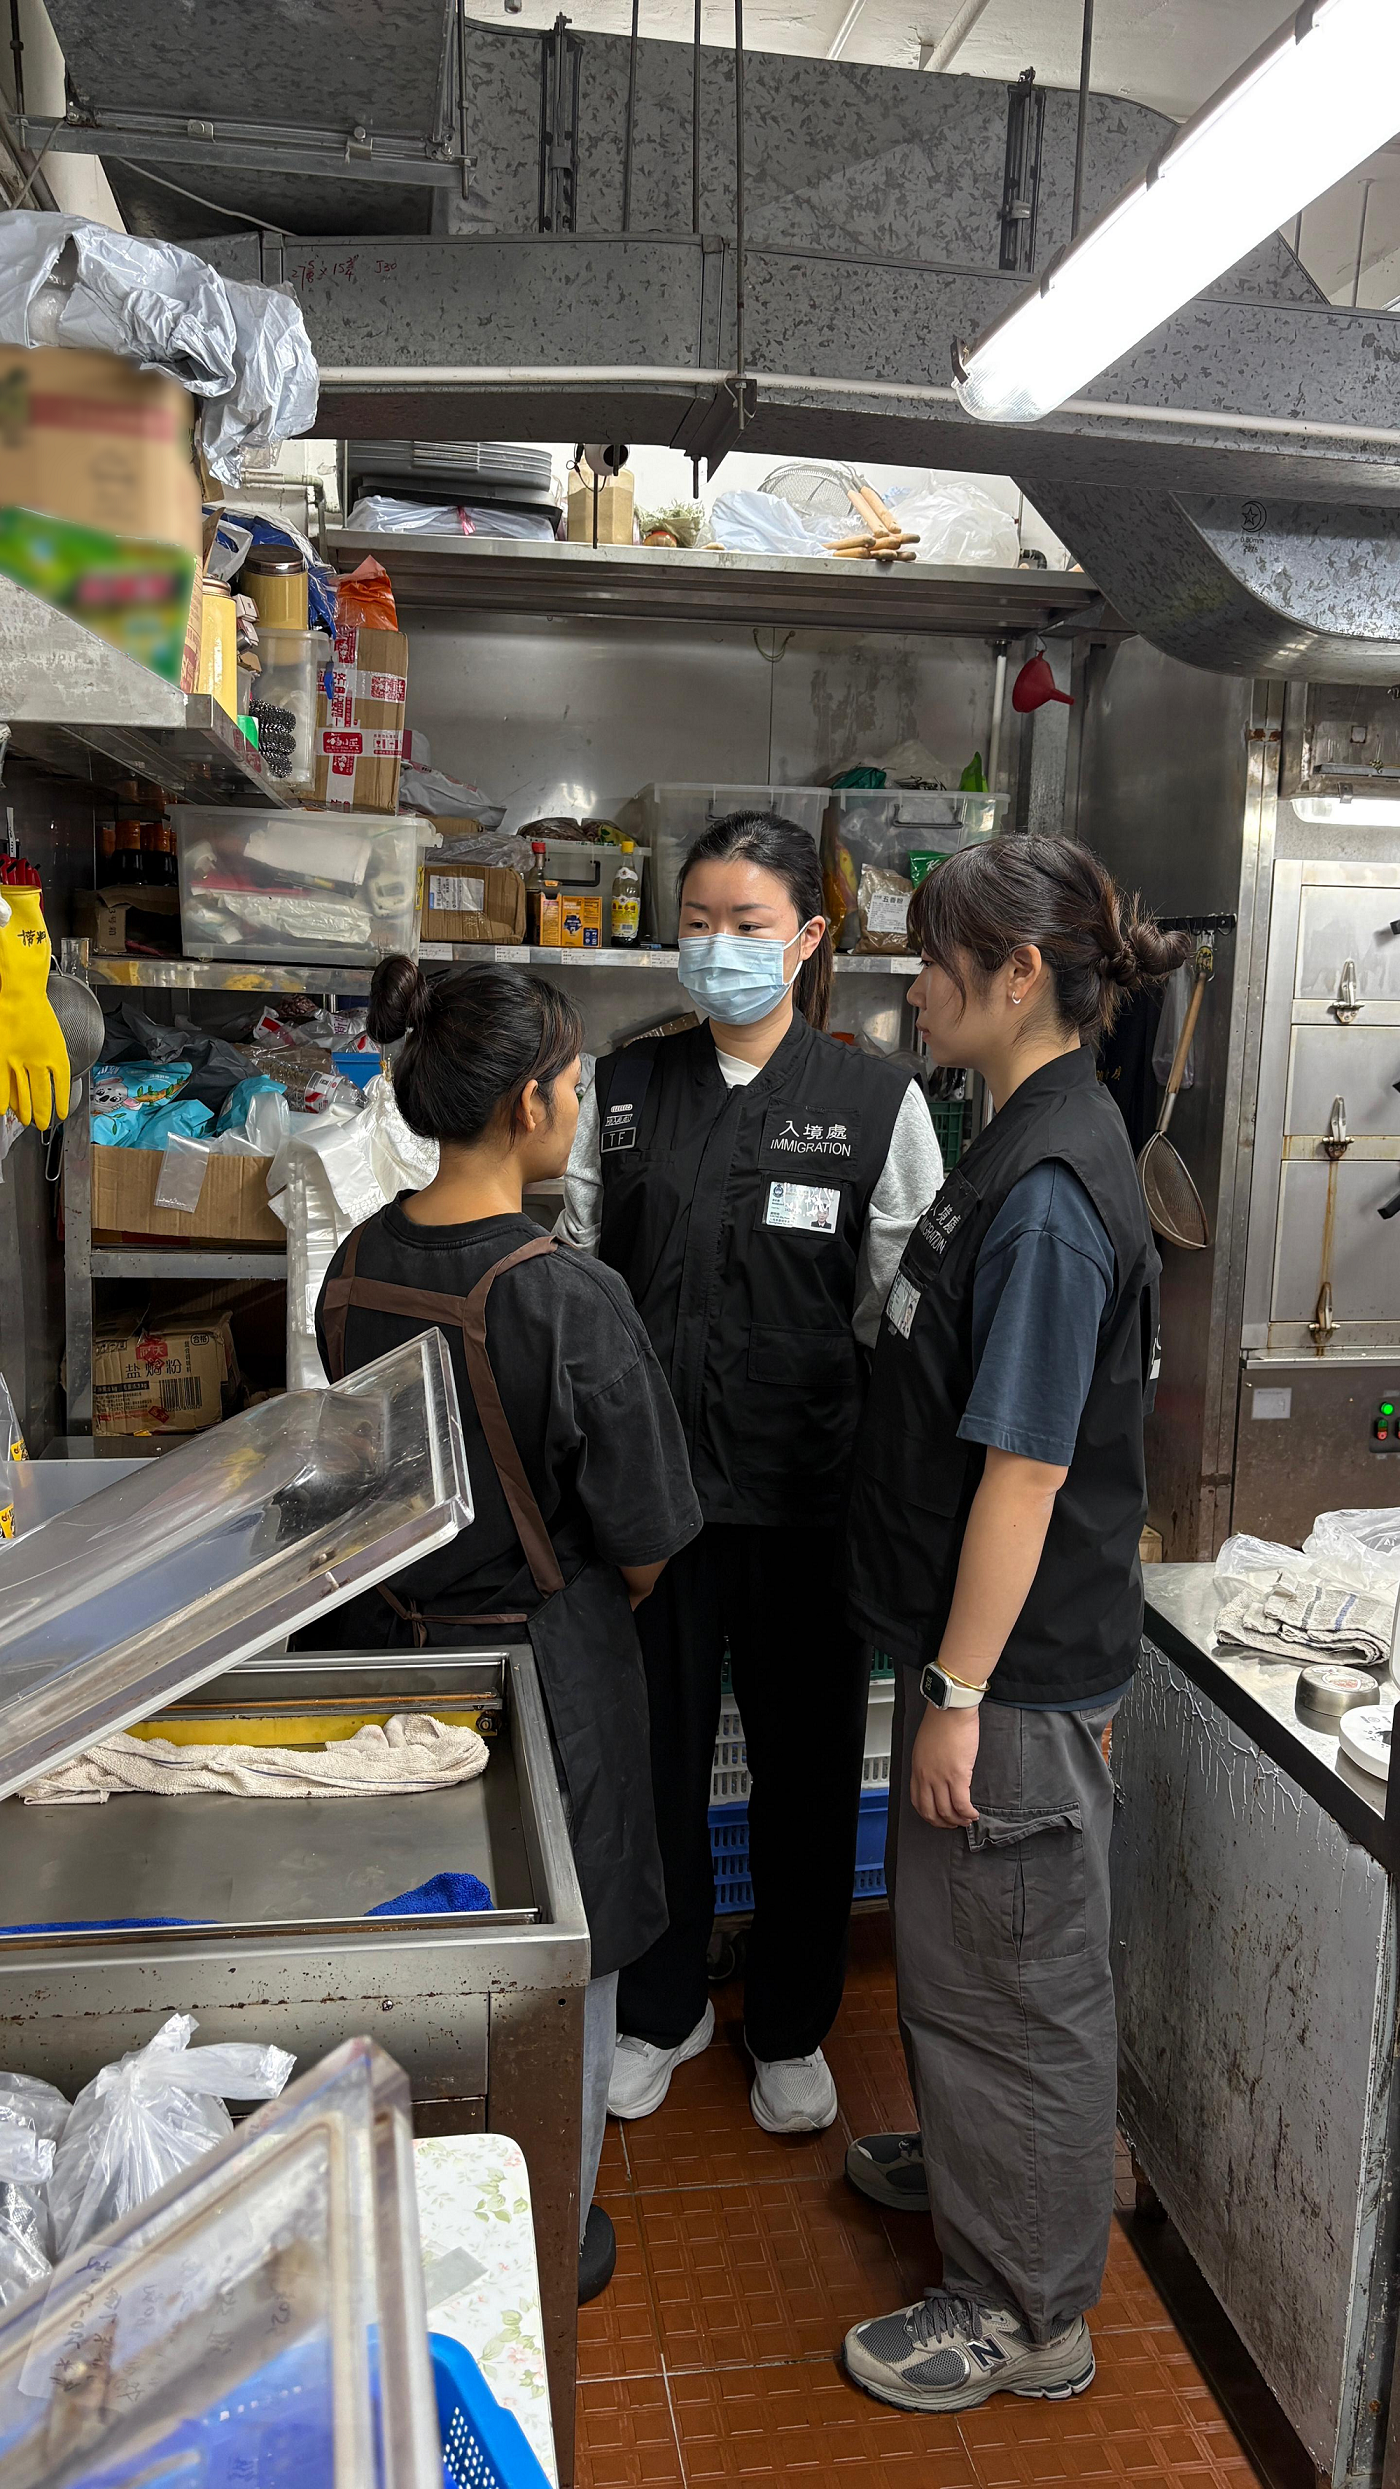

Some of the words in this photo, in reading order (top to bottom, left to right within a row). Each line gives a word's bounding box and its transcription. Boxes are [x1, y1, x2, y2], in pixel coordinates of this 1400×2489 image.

[779, 1120, 847, 1140] 入境處
[770, 1138, 852, 1157] IMMIGRATION
[192, 1334, 208, 1344] 合格
